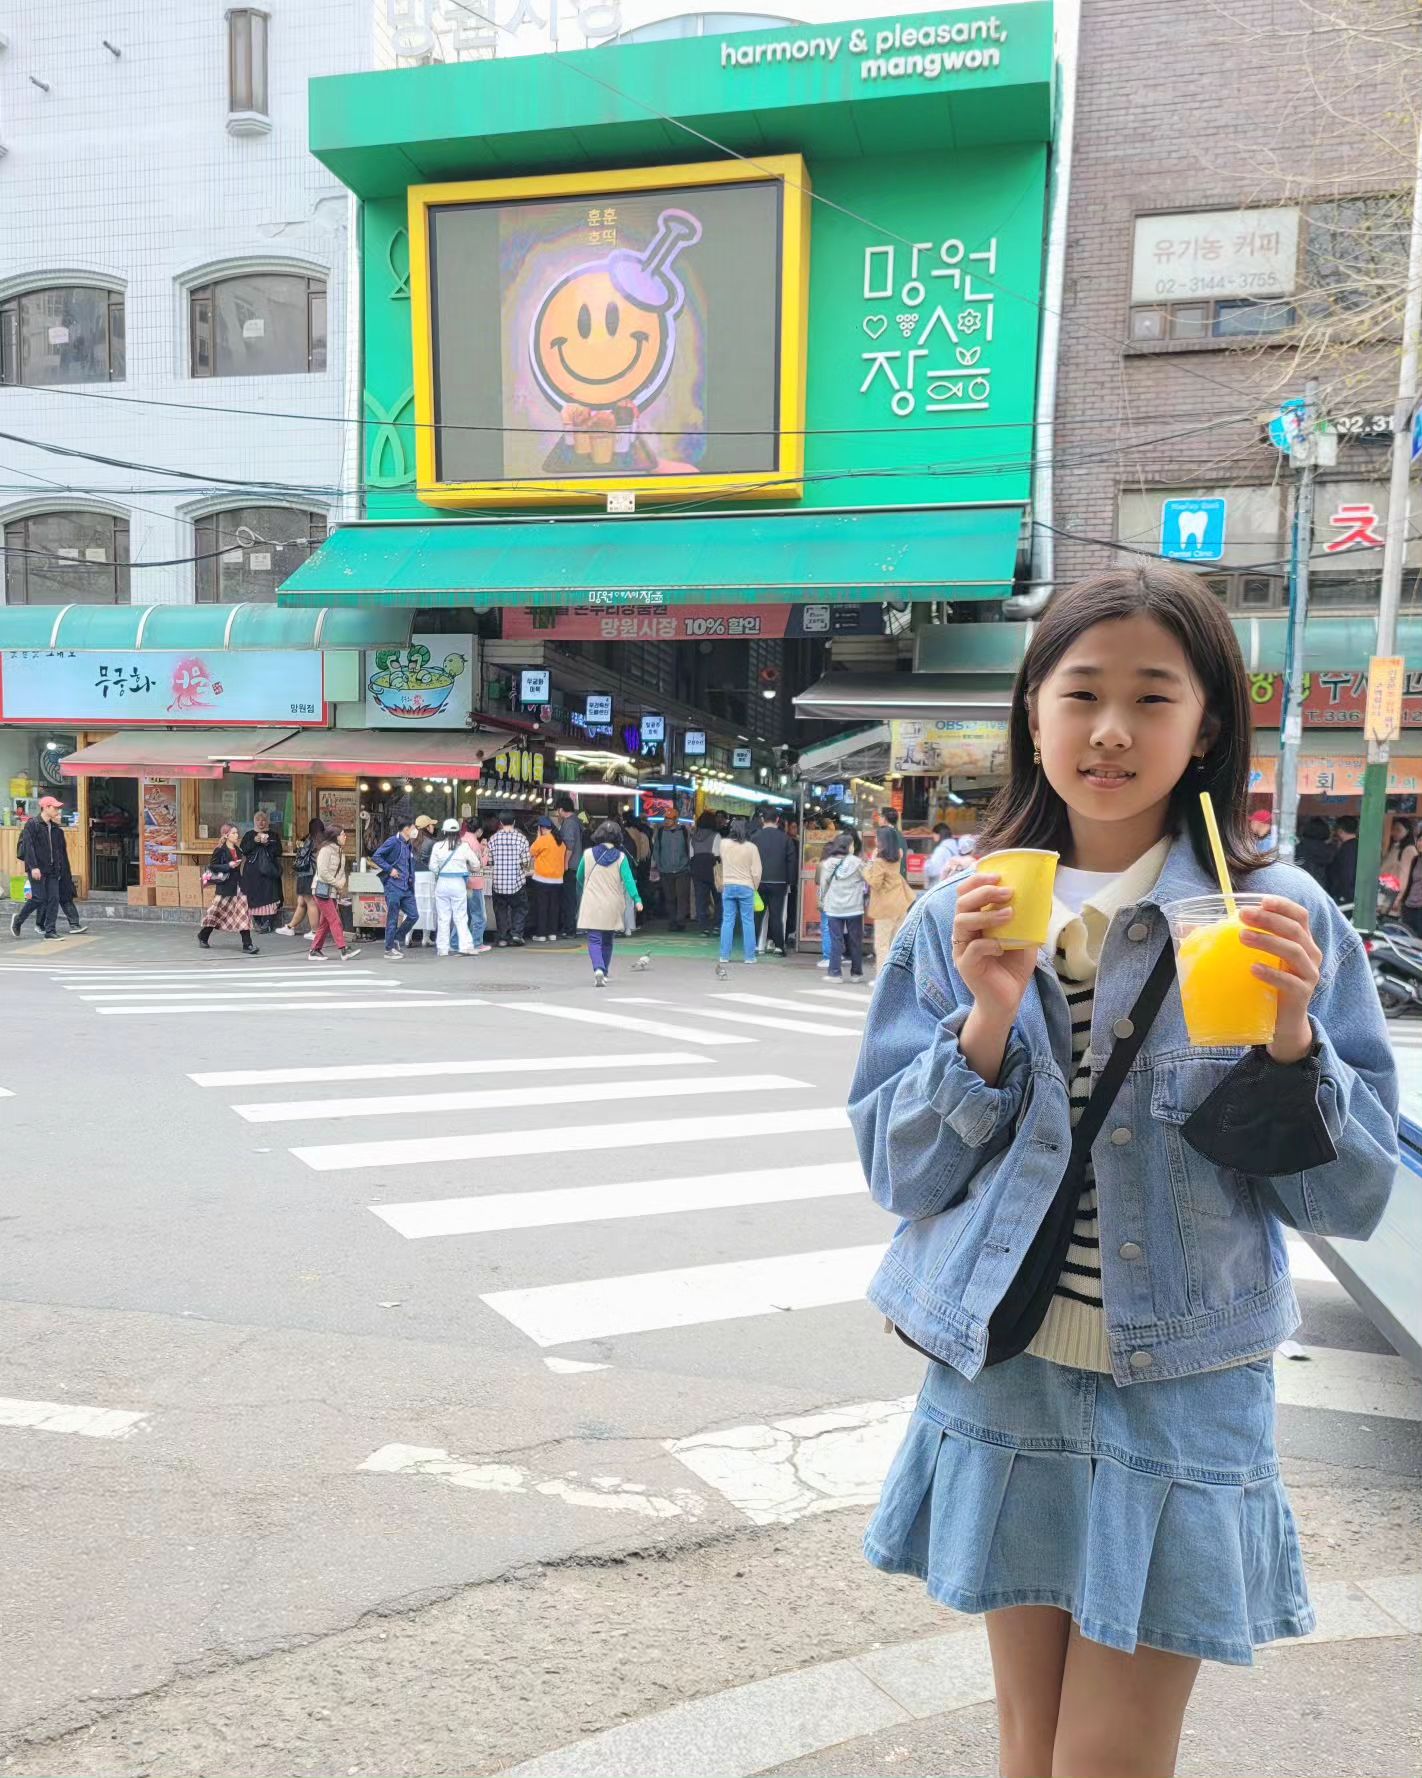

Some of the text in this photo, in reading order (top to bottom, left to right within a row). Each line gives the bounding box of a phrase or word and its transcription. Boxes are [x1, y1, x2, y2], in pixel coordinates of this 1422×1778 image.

[719, 16, 1008, 67] harmony & pleasant,
[860, 48, 1001, 80] mangwon
[587, 208, 617, 226] 훈훈
[1153, 231, 1280, 265] 유기농 커피
[1155, 272, 1278, 295] 02-3144-3755
[601, 616, 761, 638] 망원시장 10% 할인
[95, 665, 156, 698] 무궁화
[290, 703, 316, 714] 망원점
[935, 720, 964, 730] OBS
